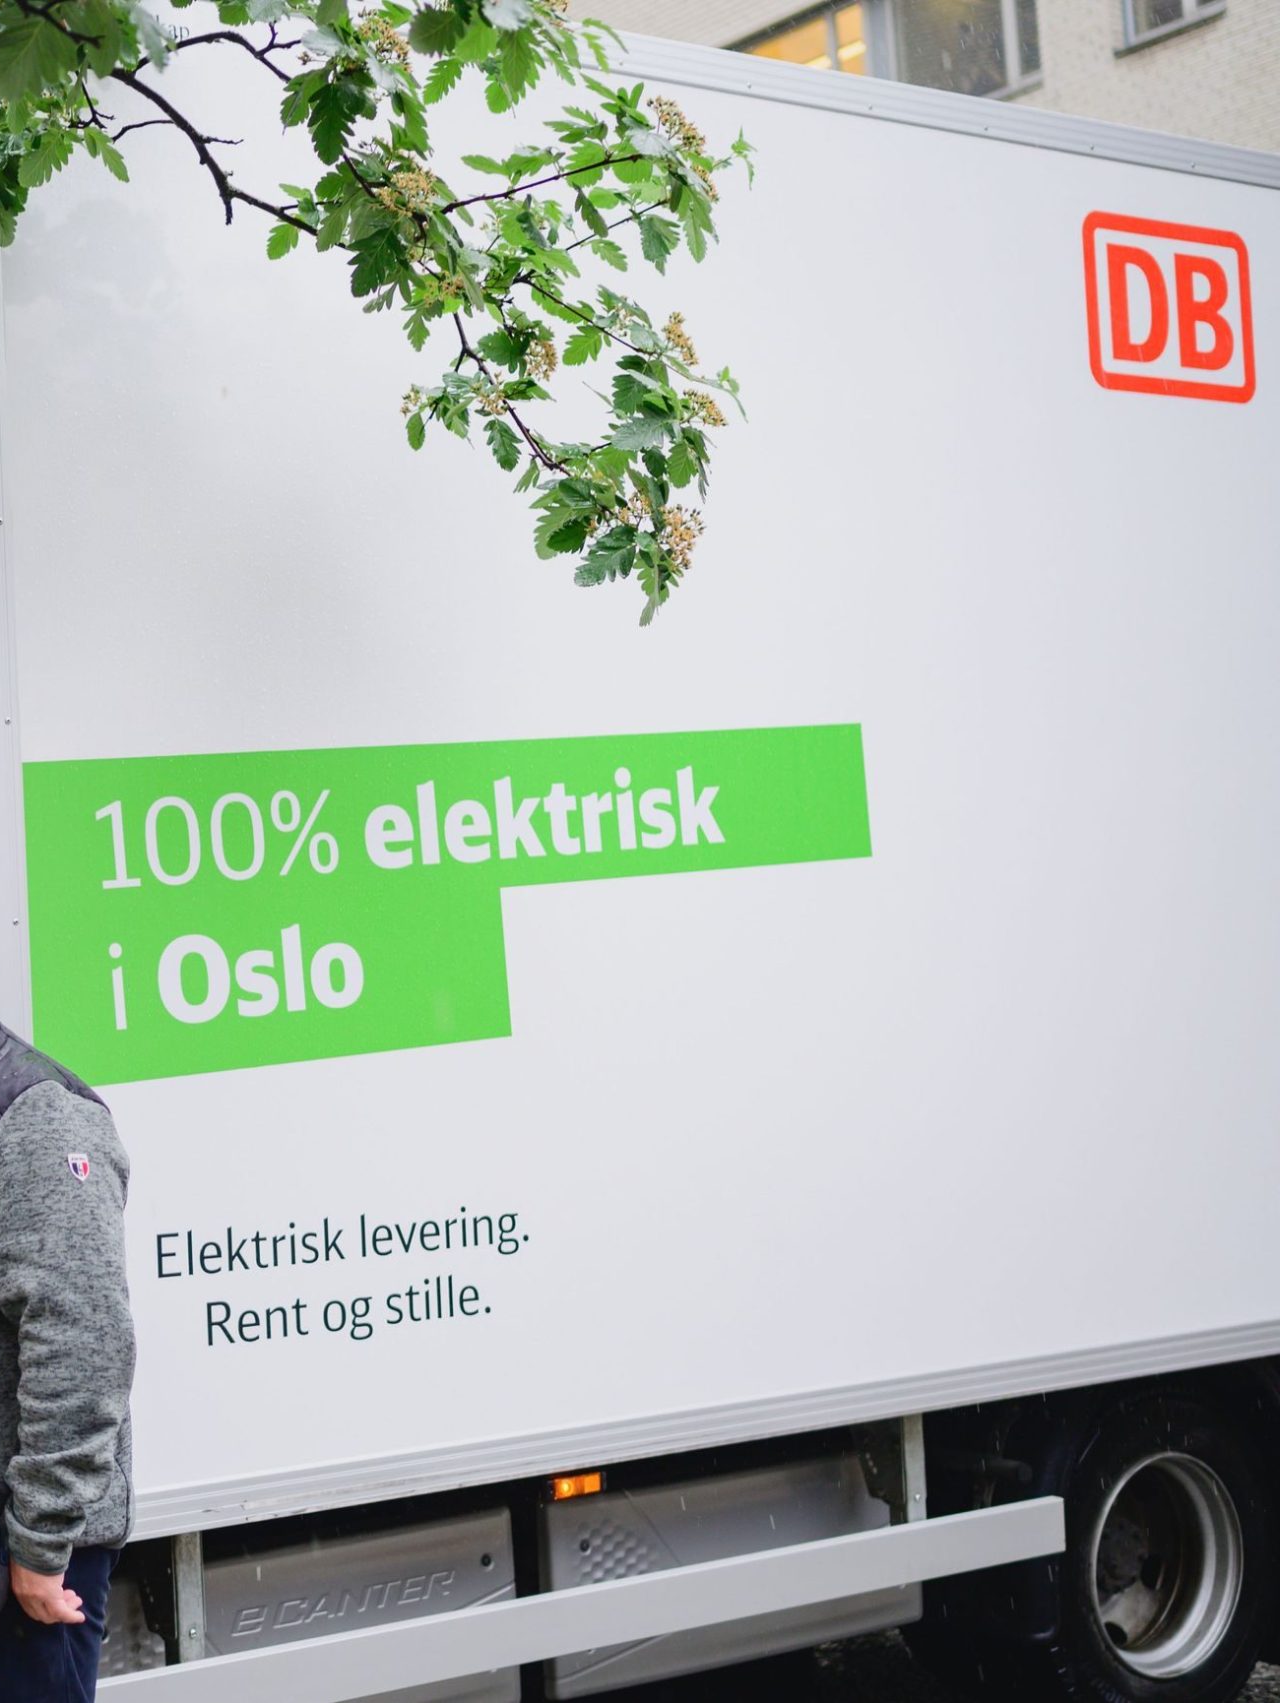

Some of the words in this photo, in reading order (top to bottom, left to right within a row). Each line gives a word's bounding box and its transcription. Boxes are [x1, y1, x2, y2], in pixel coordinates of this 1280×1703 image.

[1104, 240, 1236, 372] DB
[94, 788, 341, 890] 100%
[364, 766, 726, 869] elektrisk
[108, 942, 129, 1031] i
[157, 923, 365, 1025] Oslo
[156, 1217, 345, 1279] Elektrisk
[360, 1206, 530, 1258] levering.
[206, 1298, 309, 1346] Rent
[323, 1296, 373, 1341] og
[386, 1275, 492, 1326] stille.
